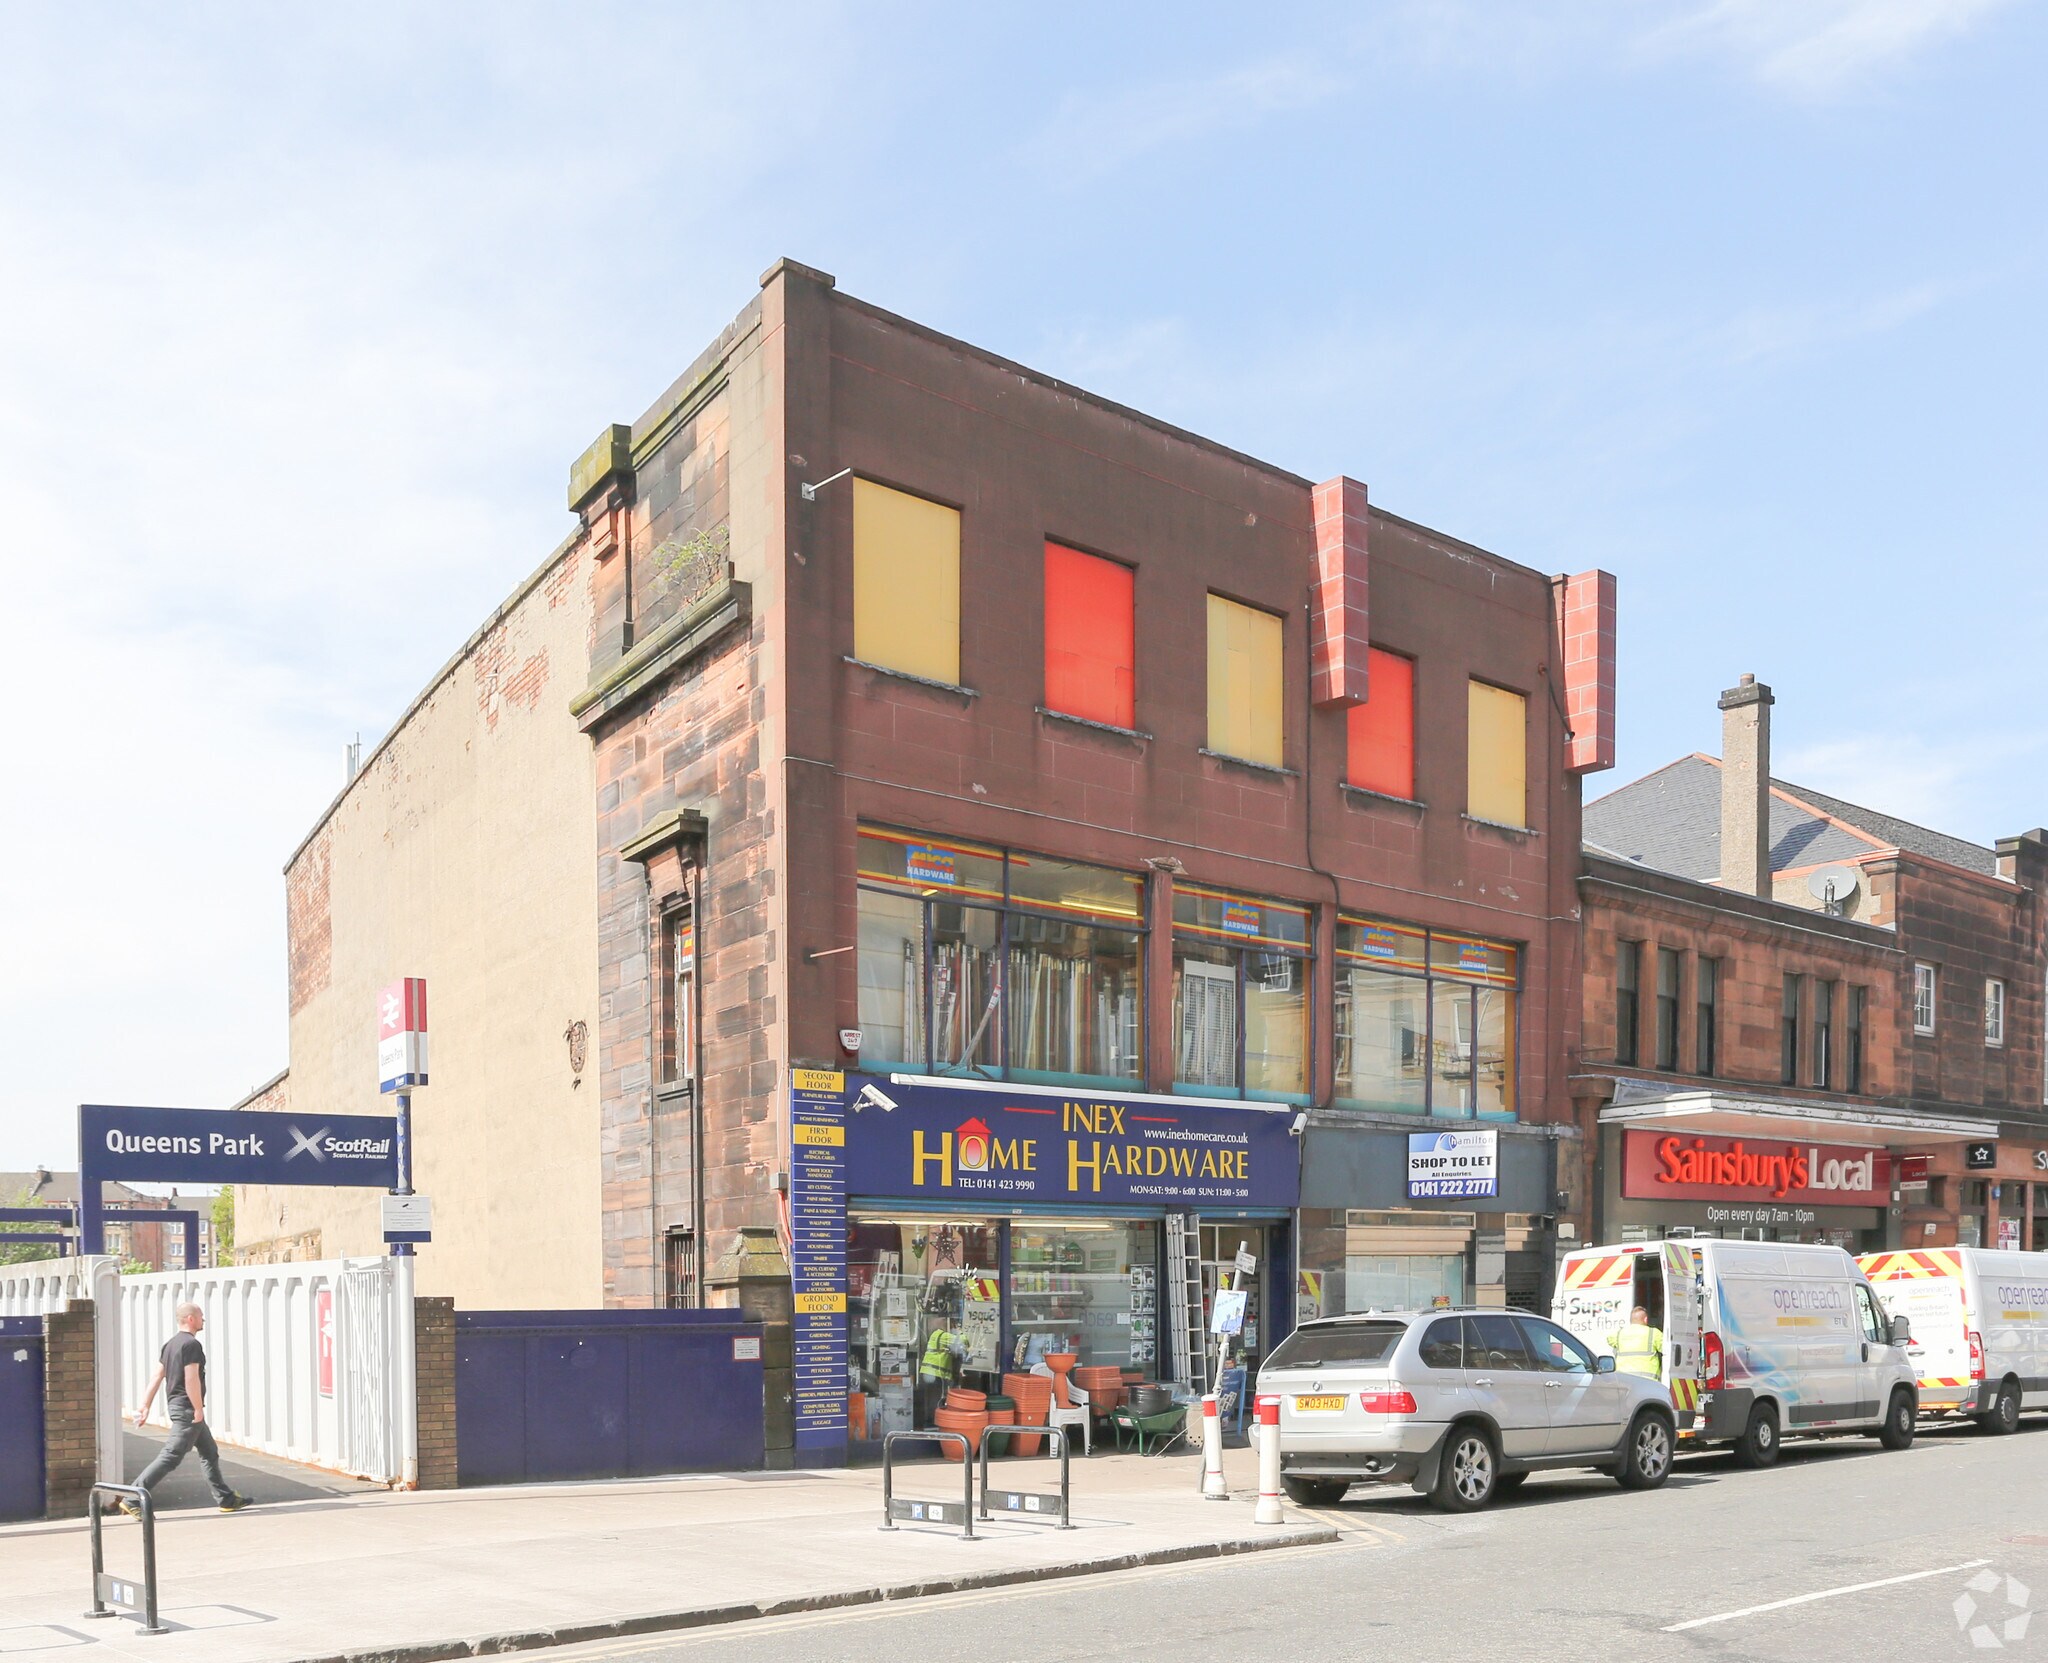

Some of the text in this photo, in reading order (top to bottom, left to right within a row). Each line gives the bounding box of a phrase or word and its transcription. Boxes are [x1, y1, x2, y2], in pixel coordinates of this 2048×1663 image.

[907, 866, 954, 881] HARDWARE
[1223, 920, 1259, 932] HARDWARE
[803, 1071, 835, 1081] SECOND
[806, 1080, 832, 1090] FLOOR
[1063, 1102, 1126, 1135] INEX
[809, 1127, 829, 1135] FIRST
[1144, 1128, 1249, 1144] www.inexhomecare.co.uk
[105, 1129, 265, 1156] Queens Park
[324, 1137, 391, 1154] ScotRail
[806, 1135, 832, 1144] FLOOR
[1067, 1140, 1249, 1192] HARDWARE
[1411, 1156, 1493, 1169] SHOP TO LET
[1658, 1136, 1873, 1198] Sainsbury's Local
[958, 1178, 1035, 1191] TEL: 0141 423 9990
[1130, 1185, 1164, 1195] MON-SAT:
[1164, 1186, 1179, 1196] 9:00
[1182, 1187, 1196, 1196] 6:00
[1198, 1187, 1215, 1196] SUN:
[1215, 1187, 1232, 1197] 11:00
[1236, 1188, 1249, 1197] 5:00
[1411, 1179, 1493, 1197] 0141 222 2777
[1707, 1206, 1729, 1223] Open
[1731, 1209, 1754, 1224] every
[1755, 1208, 1771, 1225] day
[1771, 1208, 1789, 1221] 7am
[1795, 1209, 1815, 1225] 10pm
[803, 1295, 839, 1303] GROUND
[1773, 1286, 1842, 1313] openreach
[808, 1303, 834, 1311] FLOOR
[1569, 1297, 1622, 1318] Super
[1569, 1316, 1626, 1332] fast fibre
[1834, 1317, 1841, 1325] BT
[1298, 1398, 1341, 1409] SW03 HXD
[1010, 1495, 1018, 1509] P
[914, 1504, 922, 1518] P
